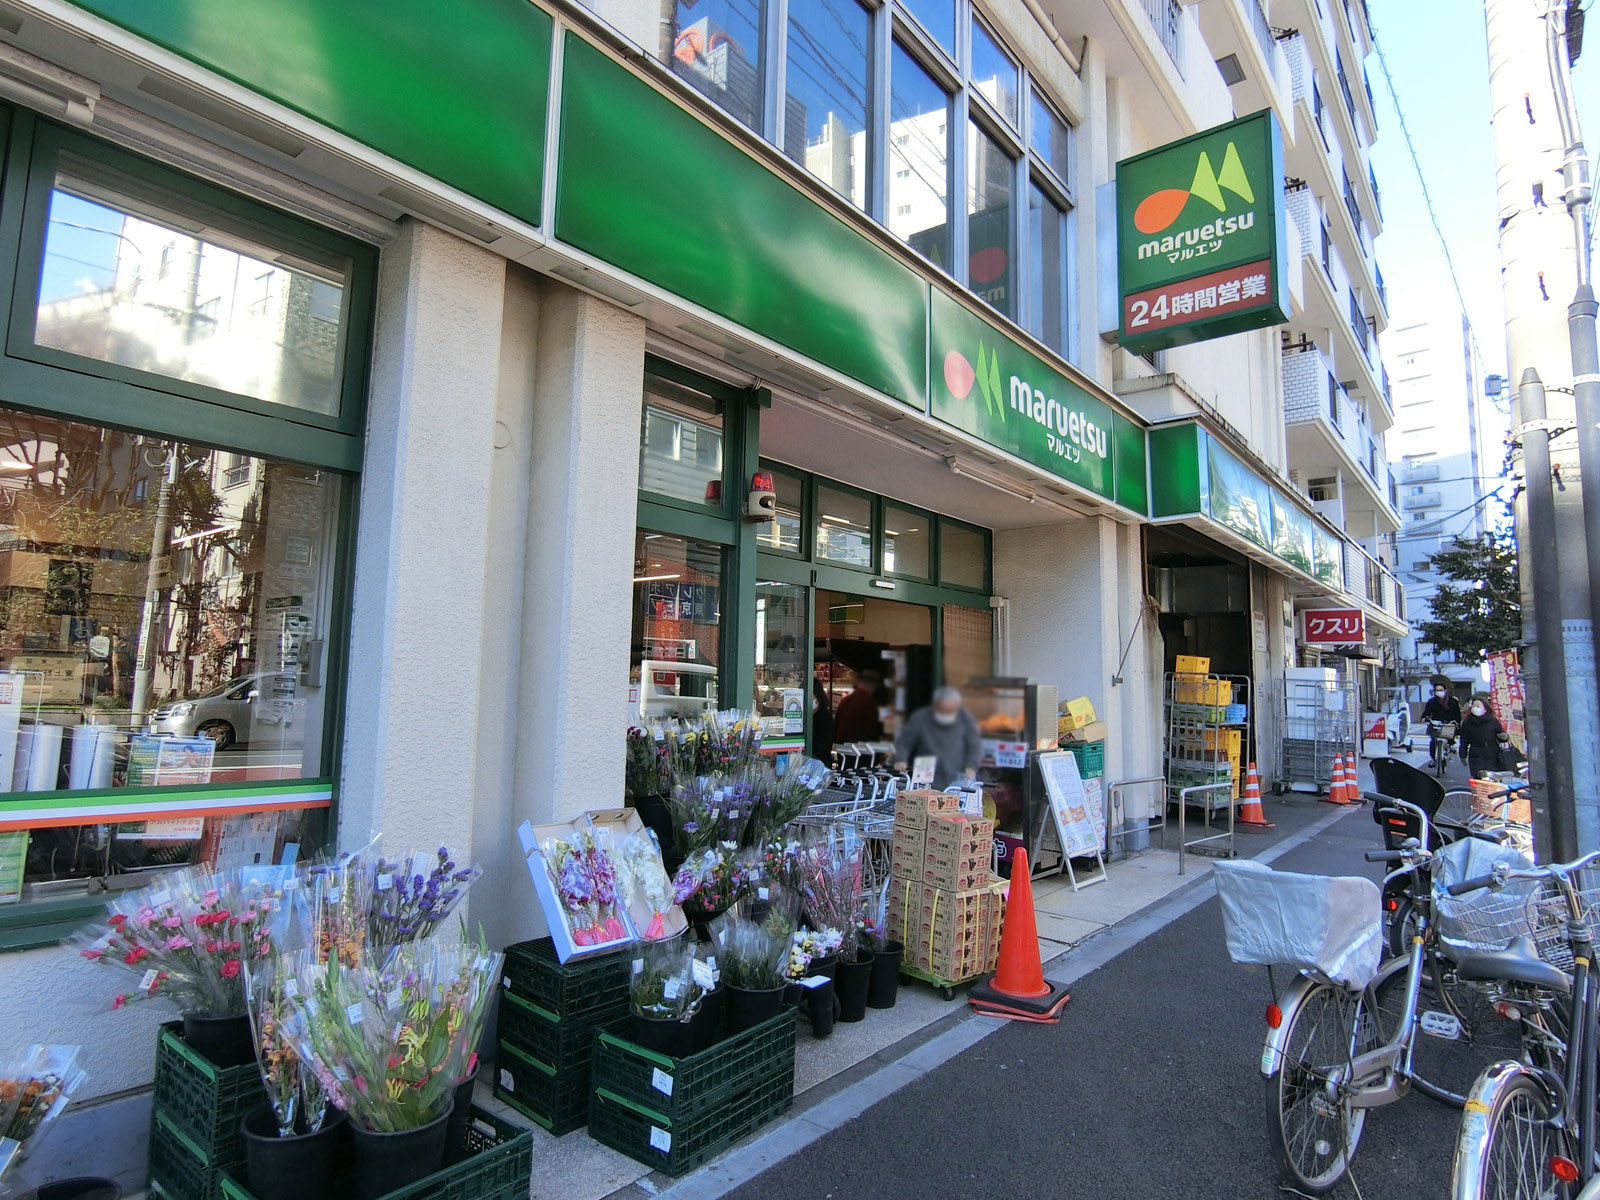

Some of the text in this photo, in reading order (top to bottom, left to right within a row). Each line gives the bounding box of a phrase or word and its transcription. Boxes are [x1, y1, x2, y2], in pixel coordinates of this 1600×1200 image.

[1138, 212, 1254, 260] maruetsu
[1167, 239, 1222, 264] マルエツ
[1130, 273, 1267, 328] 24時間営業
[1010, 375, 1107, 459] maruetsu
[1046, 433, 1080, 464] マルエツ
[1309, 617, 1360, 635] クスリ
